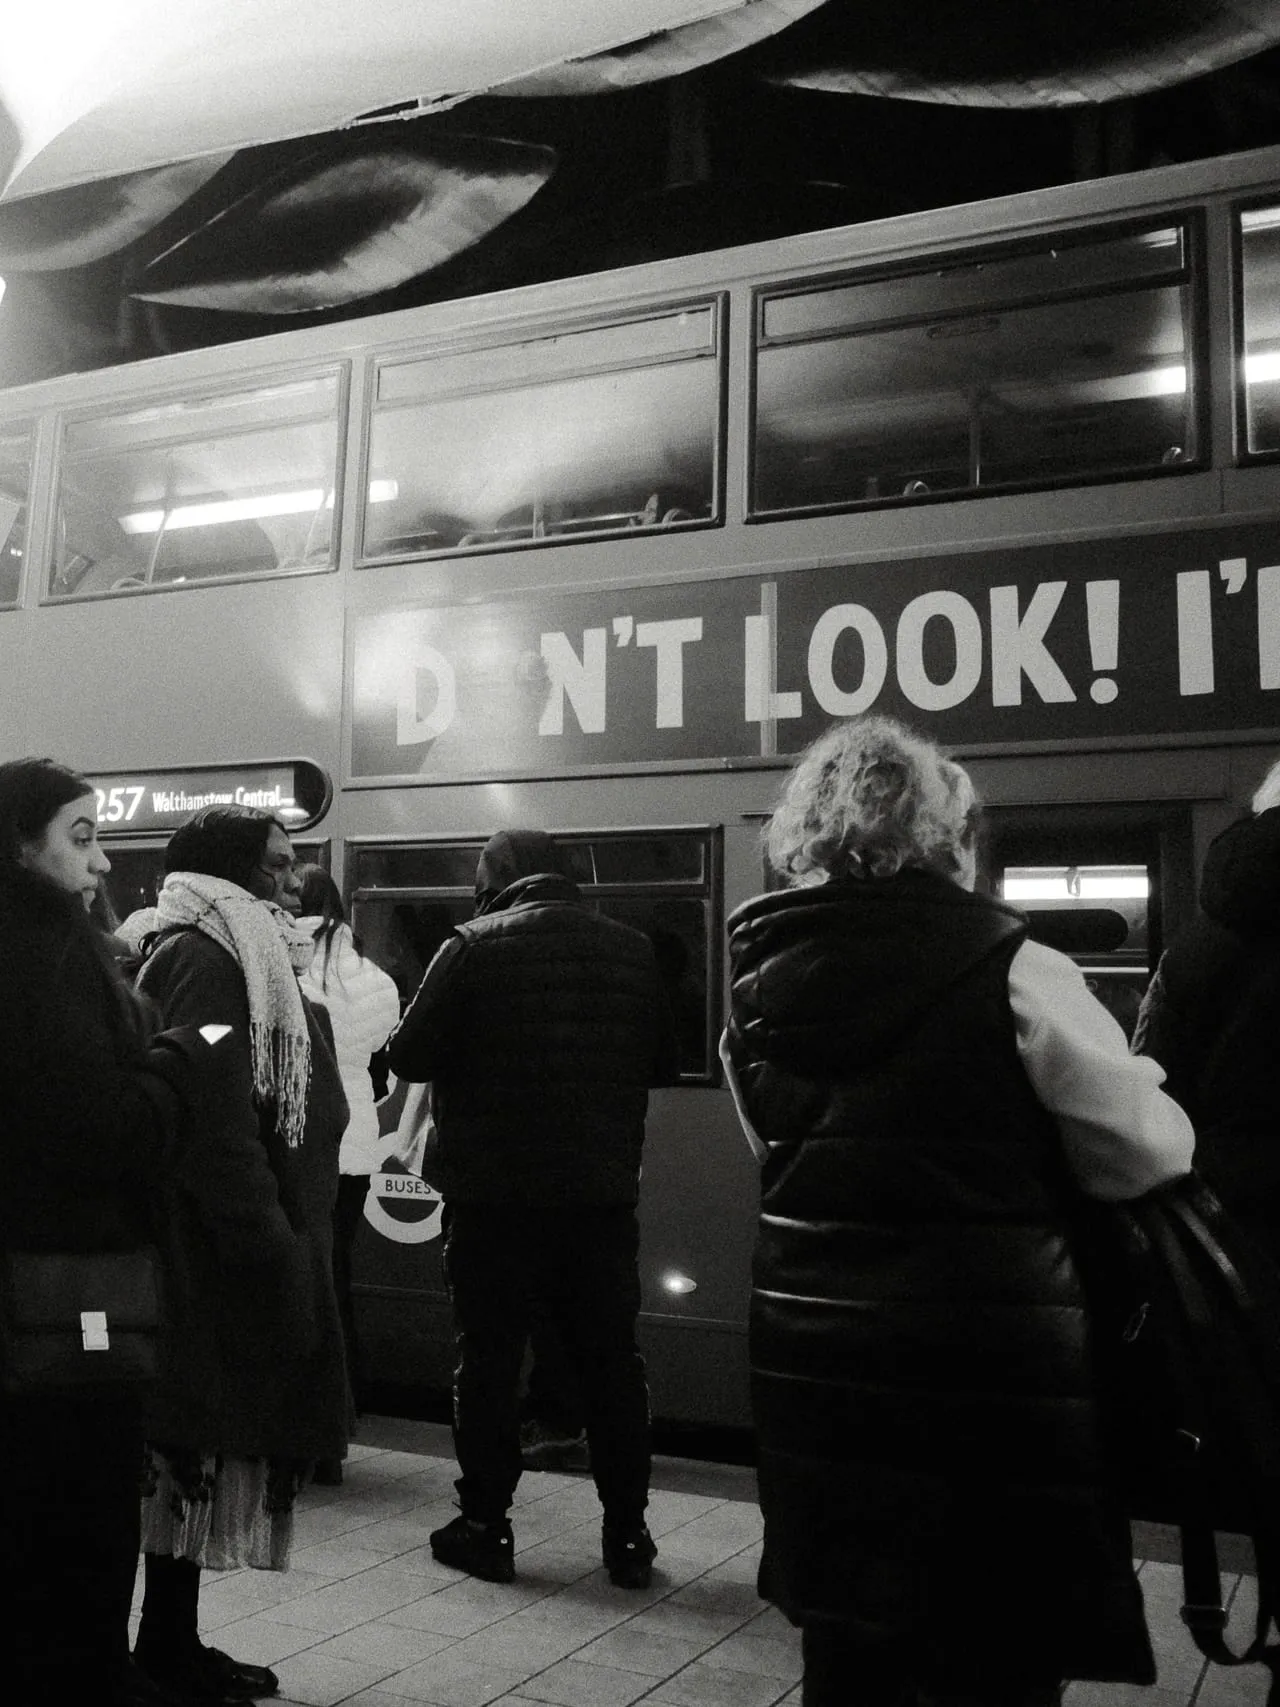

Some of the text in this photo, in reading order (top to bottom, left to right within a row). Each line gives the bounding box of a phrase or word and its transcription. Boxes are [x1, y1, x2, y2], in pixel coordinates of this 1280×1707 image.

[397, 616, 703, 746] DN'T
[744, 579, 1120, 721] LOOK!
[152, 790, 234, 813] Walthamstow
[235, 784, 281, 808] Central
[384, 1179, 432, 1195] BUSES
